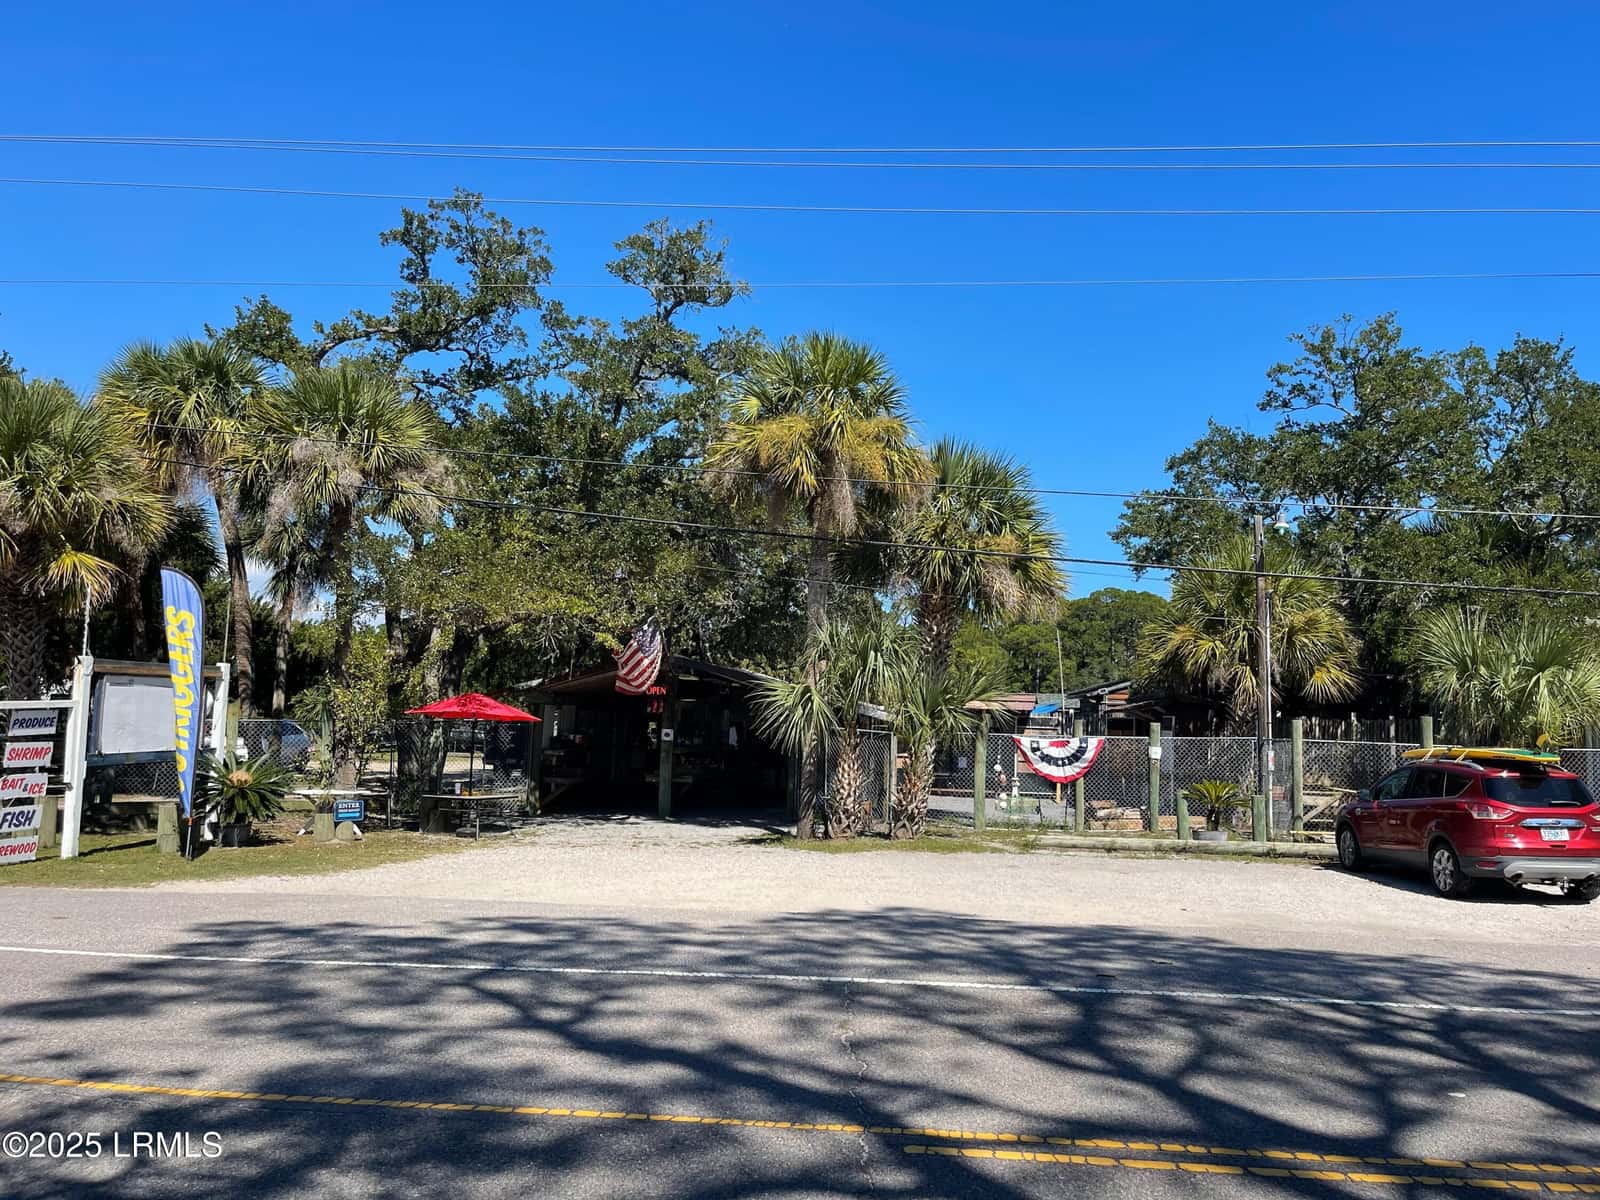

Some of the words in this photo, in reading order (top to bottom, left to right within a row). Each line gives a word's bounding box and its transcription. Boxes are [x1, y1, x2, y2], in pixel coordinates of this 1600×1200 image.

[646, 686, 666, 695] OPEN
[165, 605, 196, 794] RIGGERS
[11, 716, 57, 729] PRODUCE
[7, 746, 52, 761] SHRIMP
[0, 777, 26, 791] BAIT
[22, 783, 29, 792] &
[27, 783, 46, 794] ICE
[0, 809, 36, 829] FISH
